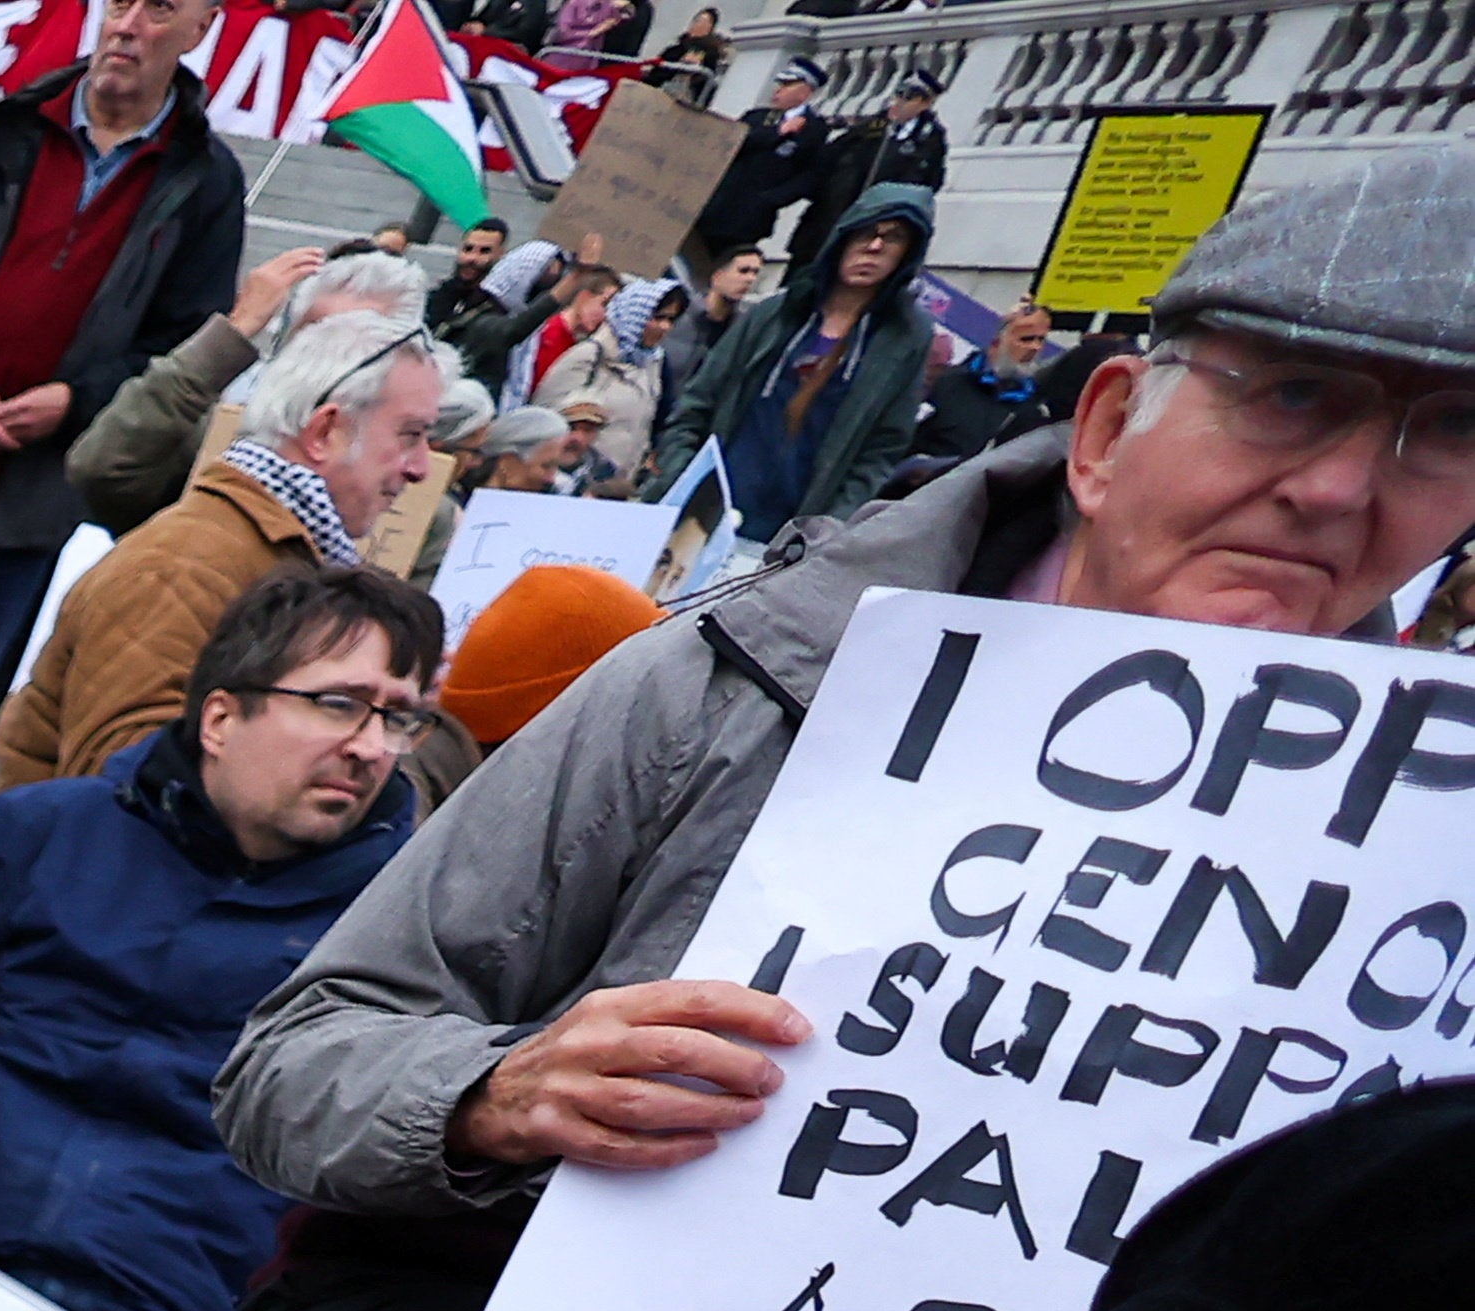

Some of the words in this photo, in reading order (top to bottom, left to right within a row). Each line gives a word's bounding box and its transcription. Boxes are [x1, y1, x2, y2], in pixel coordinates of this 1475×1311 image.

[455, 521, 511, 573] I
[886, 630, 981, 783] I
[929, 822, 1475, 1046] GENO
[835, 941, 1431, 1146] SUPP
